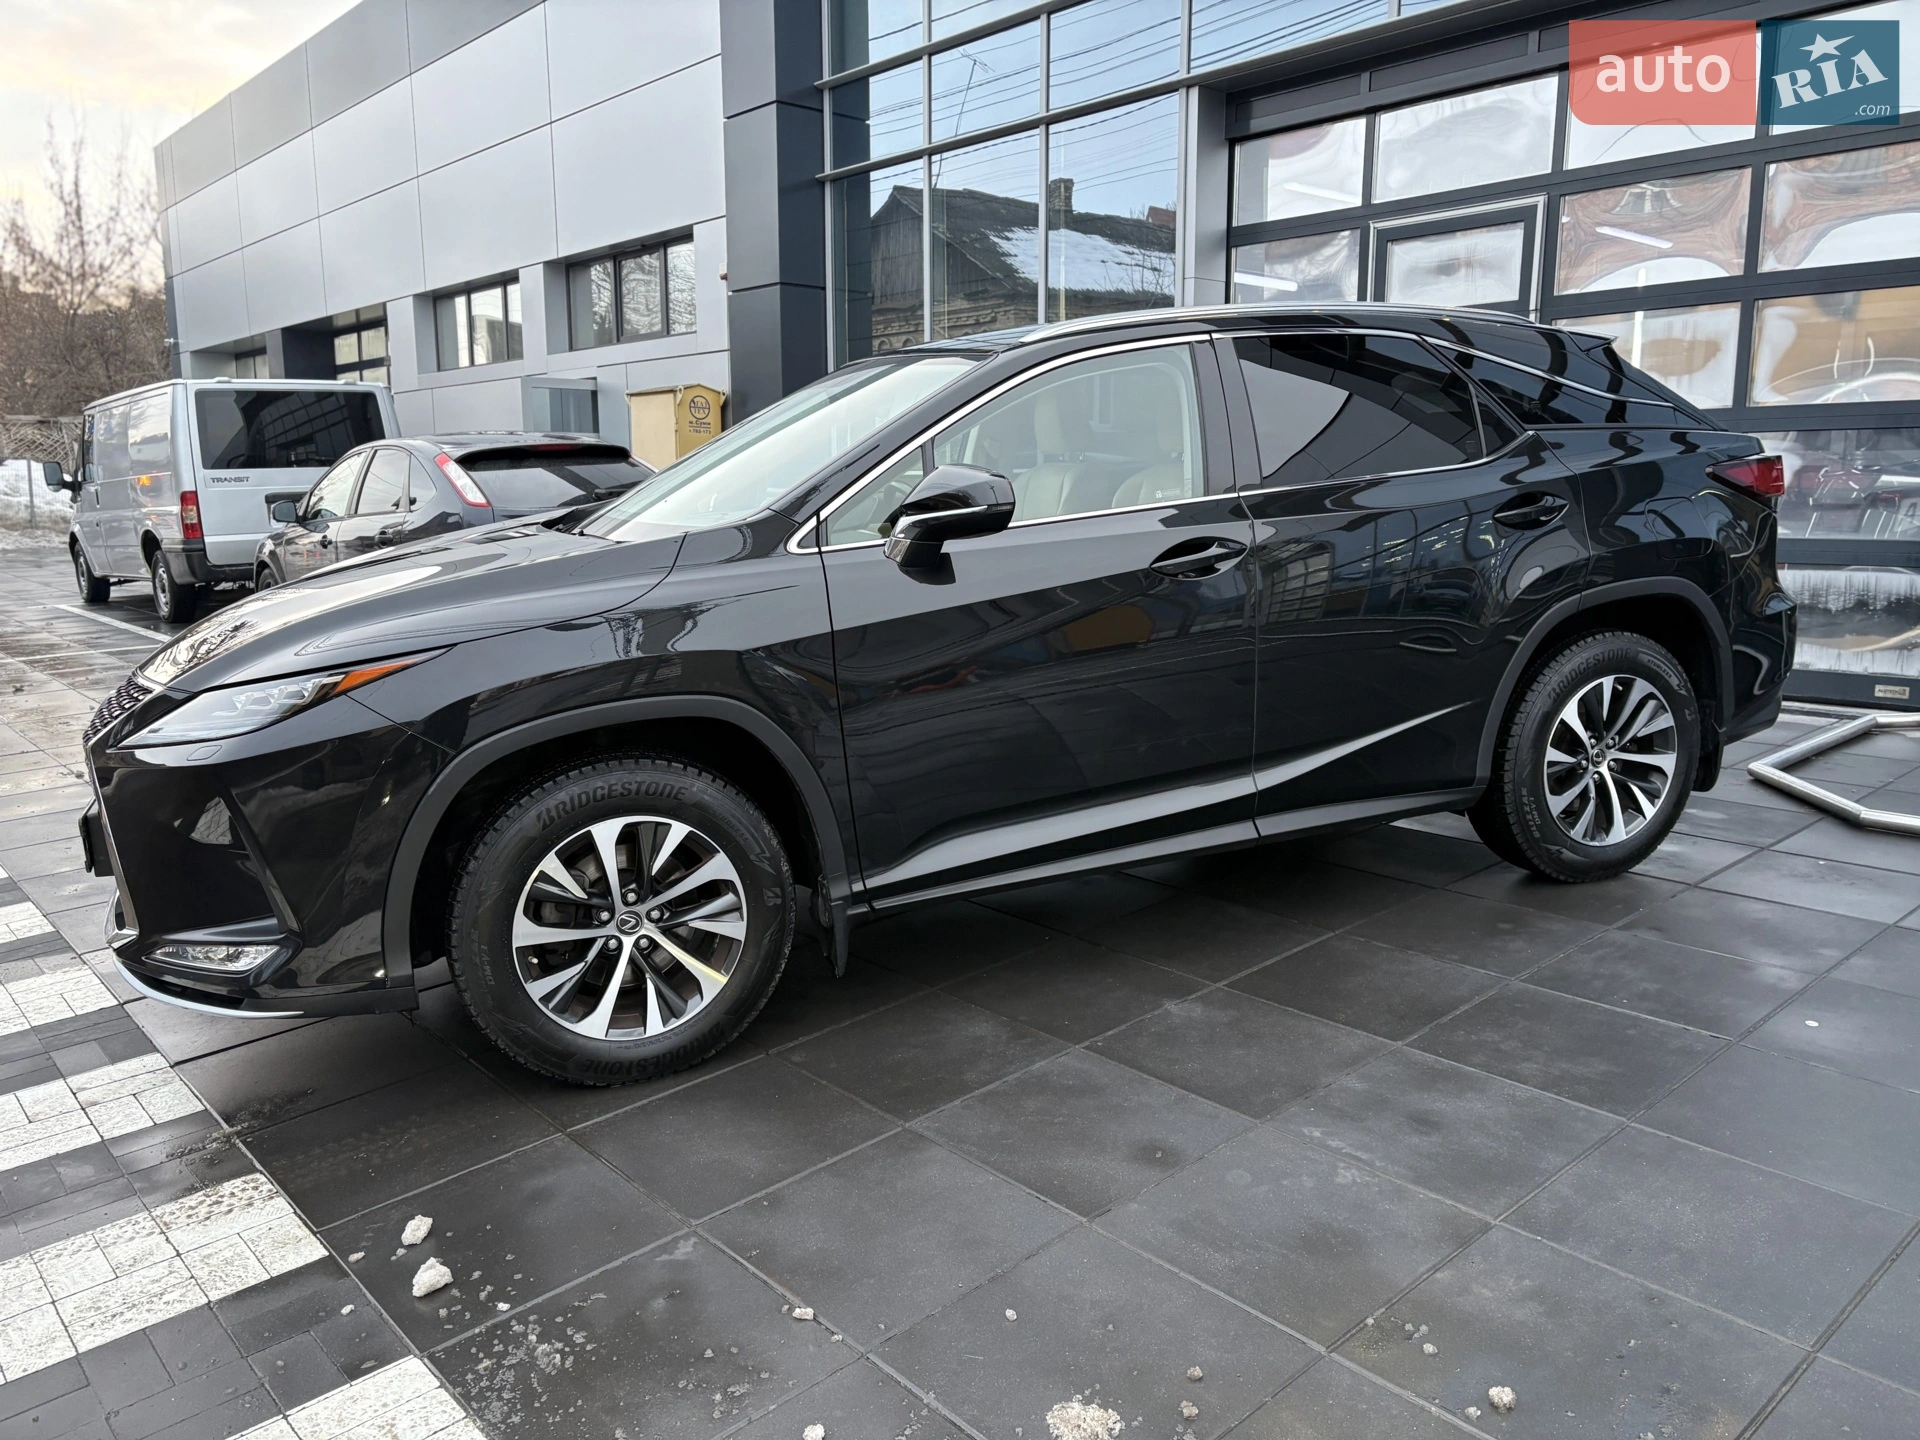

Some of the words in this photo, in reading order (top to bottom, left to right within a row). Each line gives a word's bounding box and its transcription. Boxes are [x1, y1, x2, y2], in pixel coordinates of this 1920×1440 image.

[210, 476, 250, 484] TRANSIT
[1547, 647, 1632, 703] BRIDGESTONE
[535, 780, 689, 832] BRIDGESTONE
